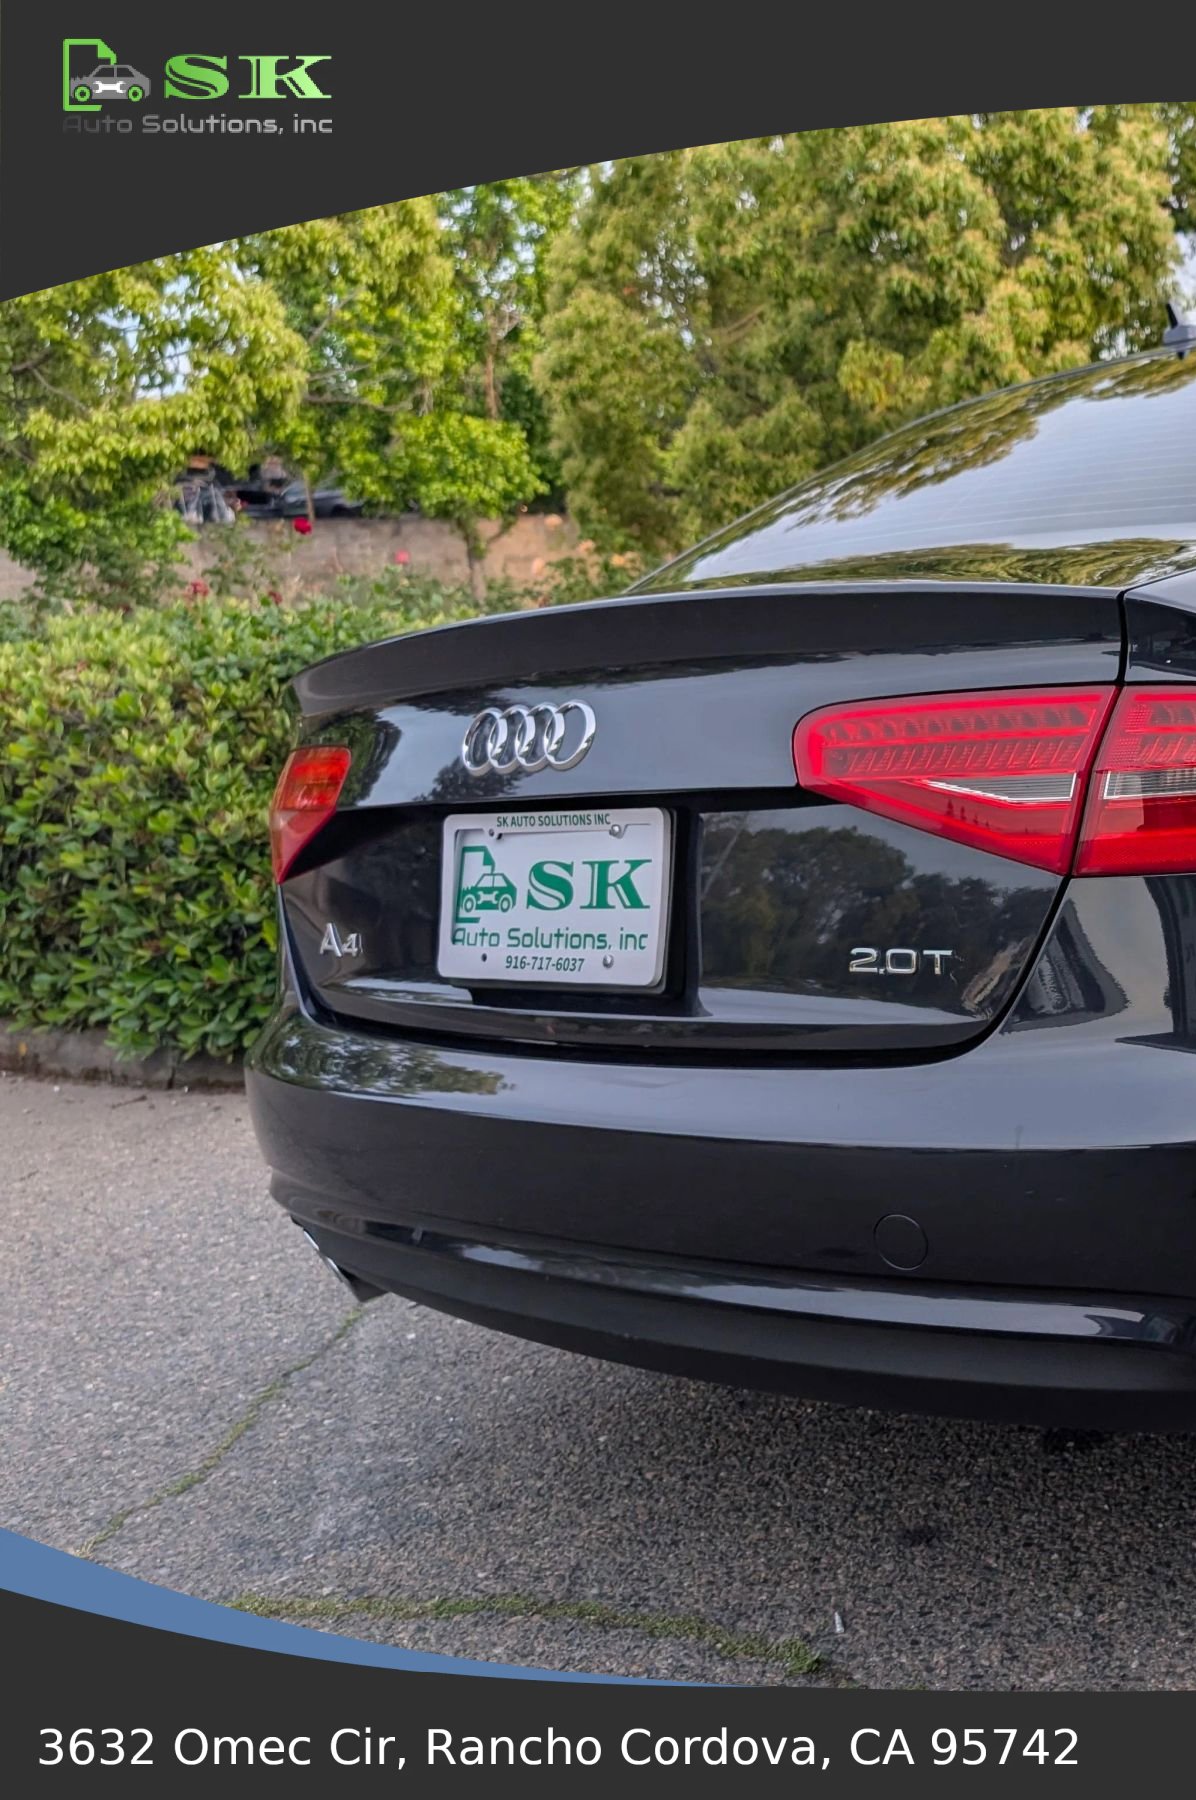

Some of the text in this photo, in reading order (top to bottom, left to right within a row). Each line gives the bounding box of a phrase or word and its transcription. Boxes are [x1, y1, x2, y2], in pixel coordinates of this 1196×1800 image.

[496, 813, 612, 828] SK AUTO SOLUTIONS INC
[526, 859, 653, 911] SK
[320, 922, 359, 957] A4
[453, 927, 649, 950] Auto Solutions, inc
[505, 955, 585, 972] 916-717-6037
